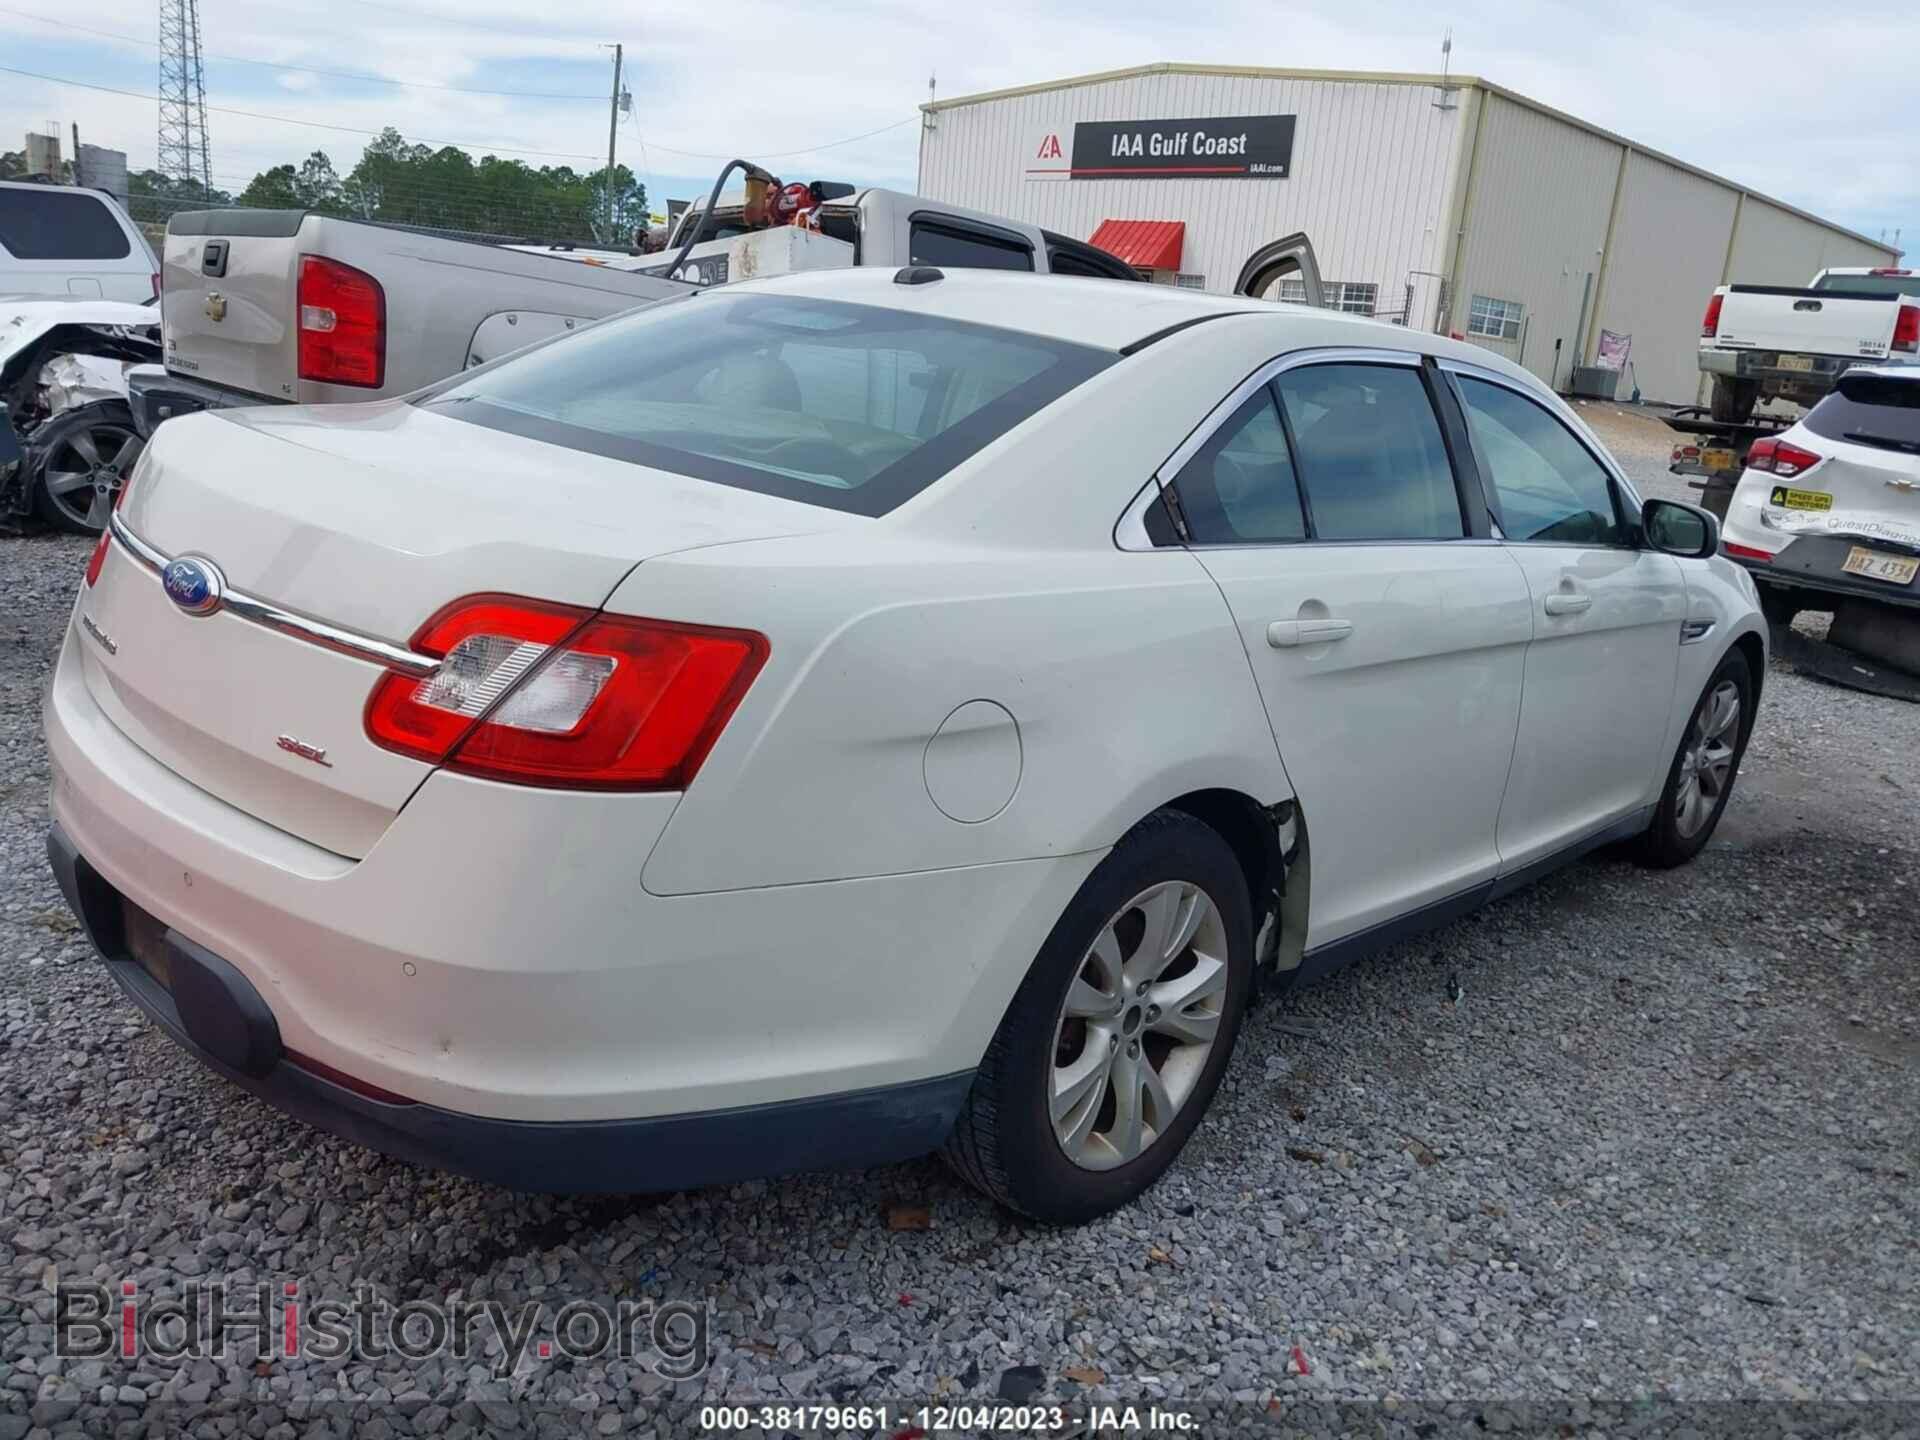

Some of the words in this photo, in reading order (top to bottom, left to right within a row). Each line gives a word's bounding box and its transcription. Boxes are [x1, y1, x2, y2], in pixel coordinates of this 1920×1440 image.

[1111, 133, 1144, 156] IAA
[1149, 132, 1189, 156] Gulf
[1192, 131, 1247, 155] Coast
[166, 564, 200, 598] Ford
